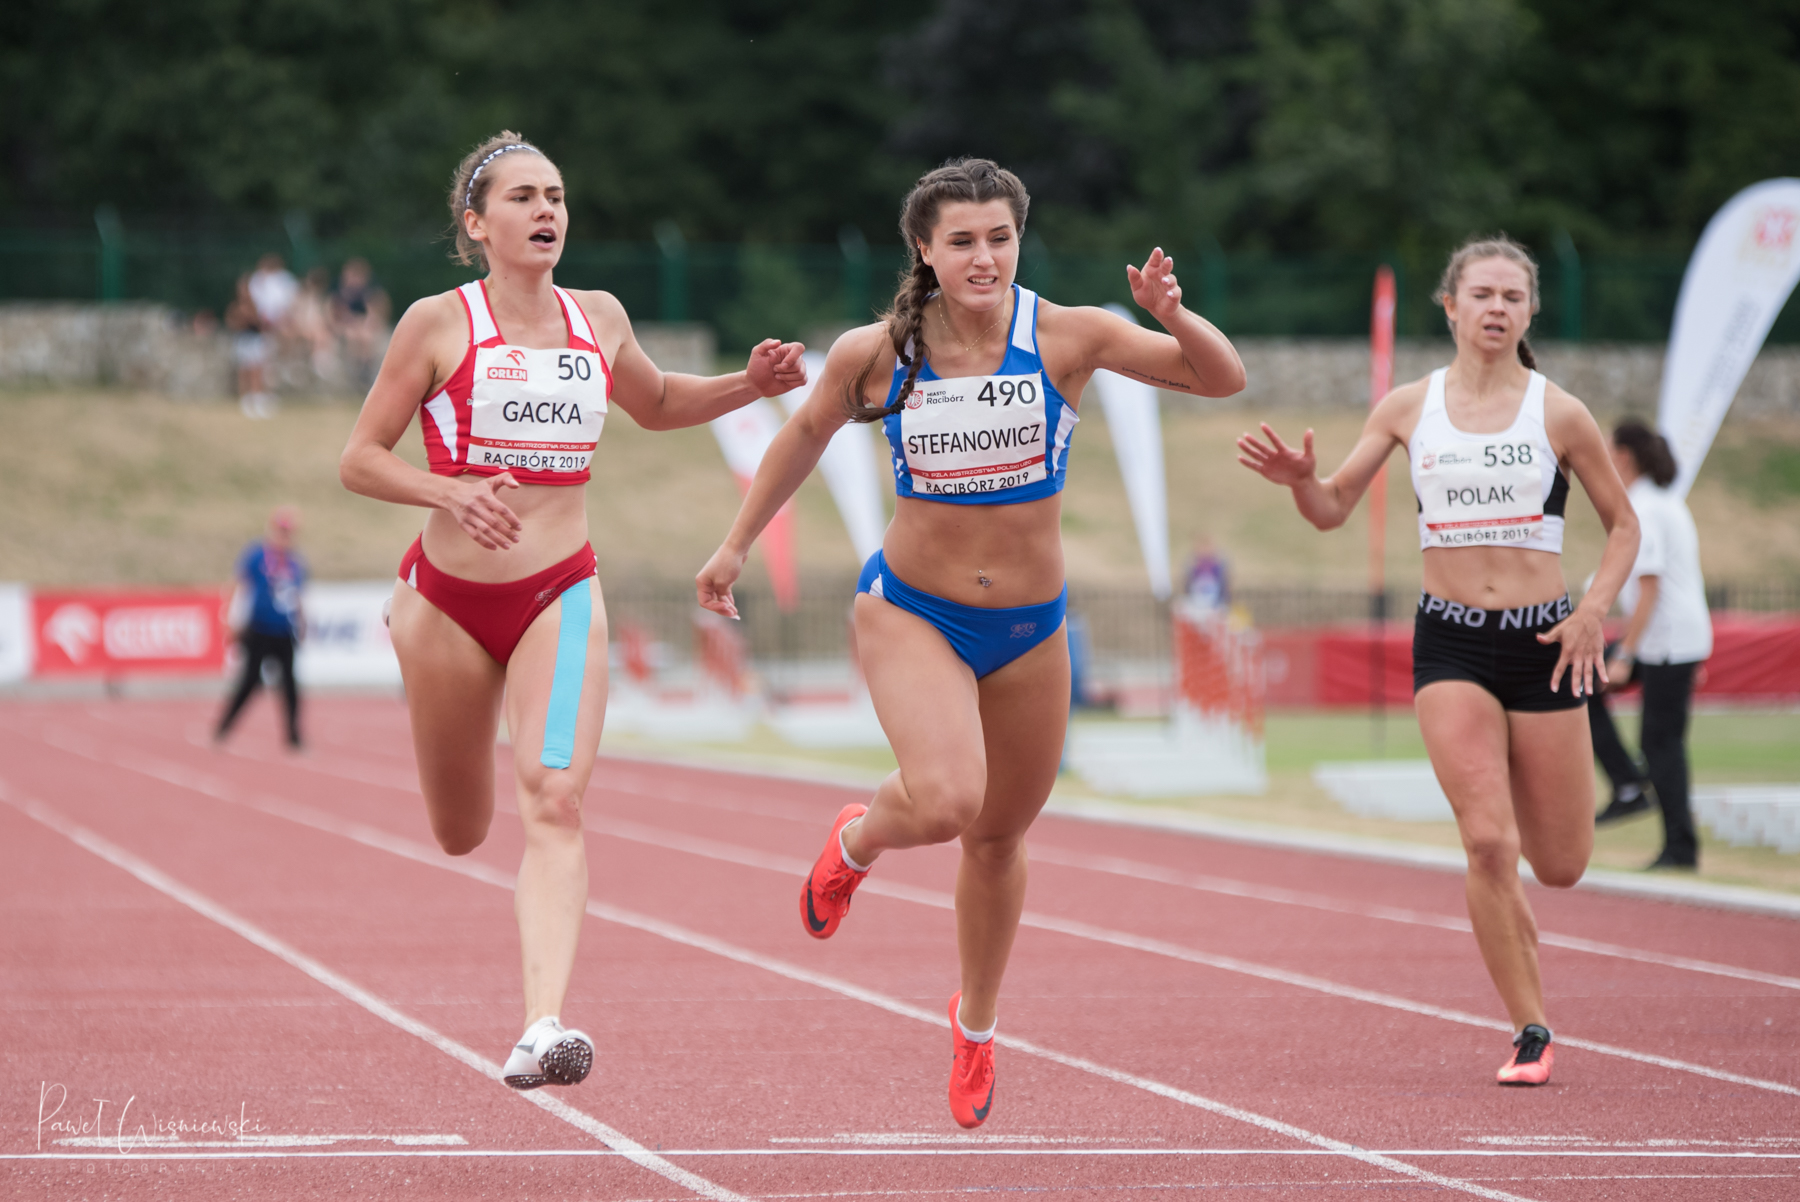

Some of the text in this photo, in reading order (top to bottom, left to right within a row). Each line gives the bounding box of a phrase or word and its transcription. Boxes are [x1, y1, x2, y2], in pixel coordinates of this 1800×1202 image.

[488, 368, 527, 380] ORLEN
[558, 354, 591, 381] 50
[926, 394, 964, 405] Racibórz
[977, 380, 1036, 407] 490
[503, 401, 582, 424] GACKA
[514, 442, 558, 450] MISTRZOSTWA
[908, 424, 1040, 455] STEFANOWICZ
[484, 452, 586, 469] RACIBÓRZ 2019
[1484, 444, 1532, 467] 538
[950, 467, 995, 477] MISTRZOSTWA
[997, 464, 1020, 472] POLSKI
[926, 472, 1029, 495] RACIBÓRZ 2019
[1447, 485, 1515, 508] POLAK
[1502, 528, 1529, 541] 2019
[1425, 594, 1487, 628] PRO
[1500, 595, 1568, 630] NIKE
